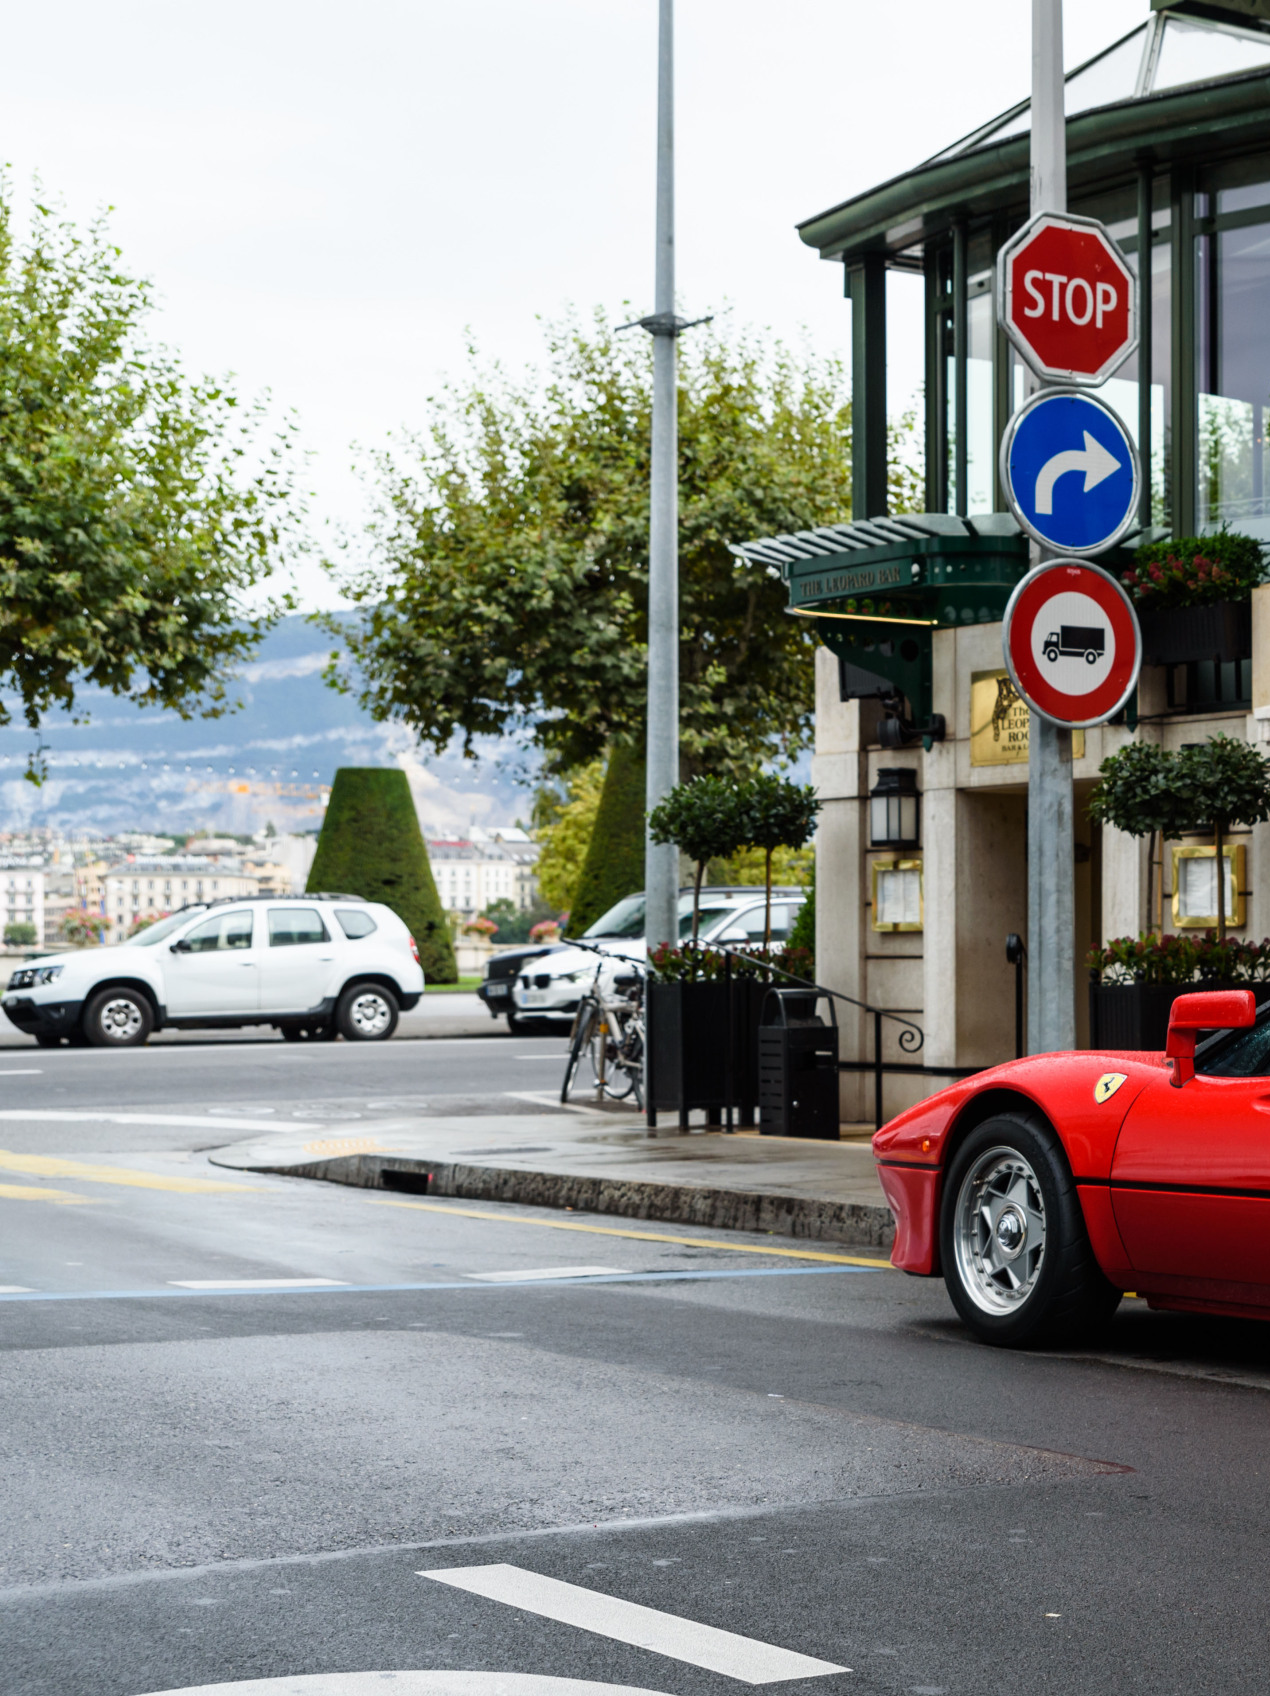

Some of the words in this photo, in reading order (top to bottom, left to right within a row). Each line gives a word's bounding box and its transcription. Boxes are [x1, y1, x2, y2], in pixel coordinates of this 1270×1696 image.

[1024, 269, 1118, 329] STOP
[800, 580, 822, 597] THE
[824, 571, 875, 593] LEOPARD
[877, 566, 901, 585] BAR
[1001, 718, 1029, 730] LEOP
